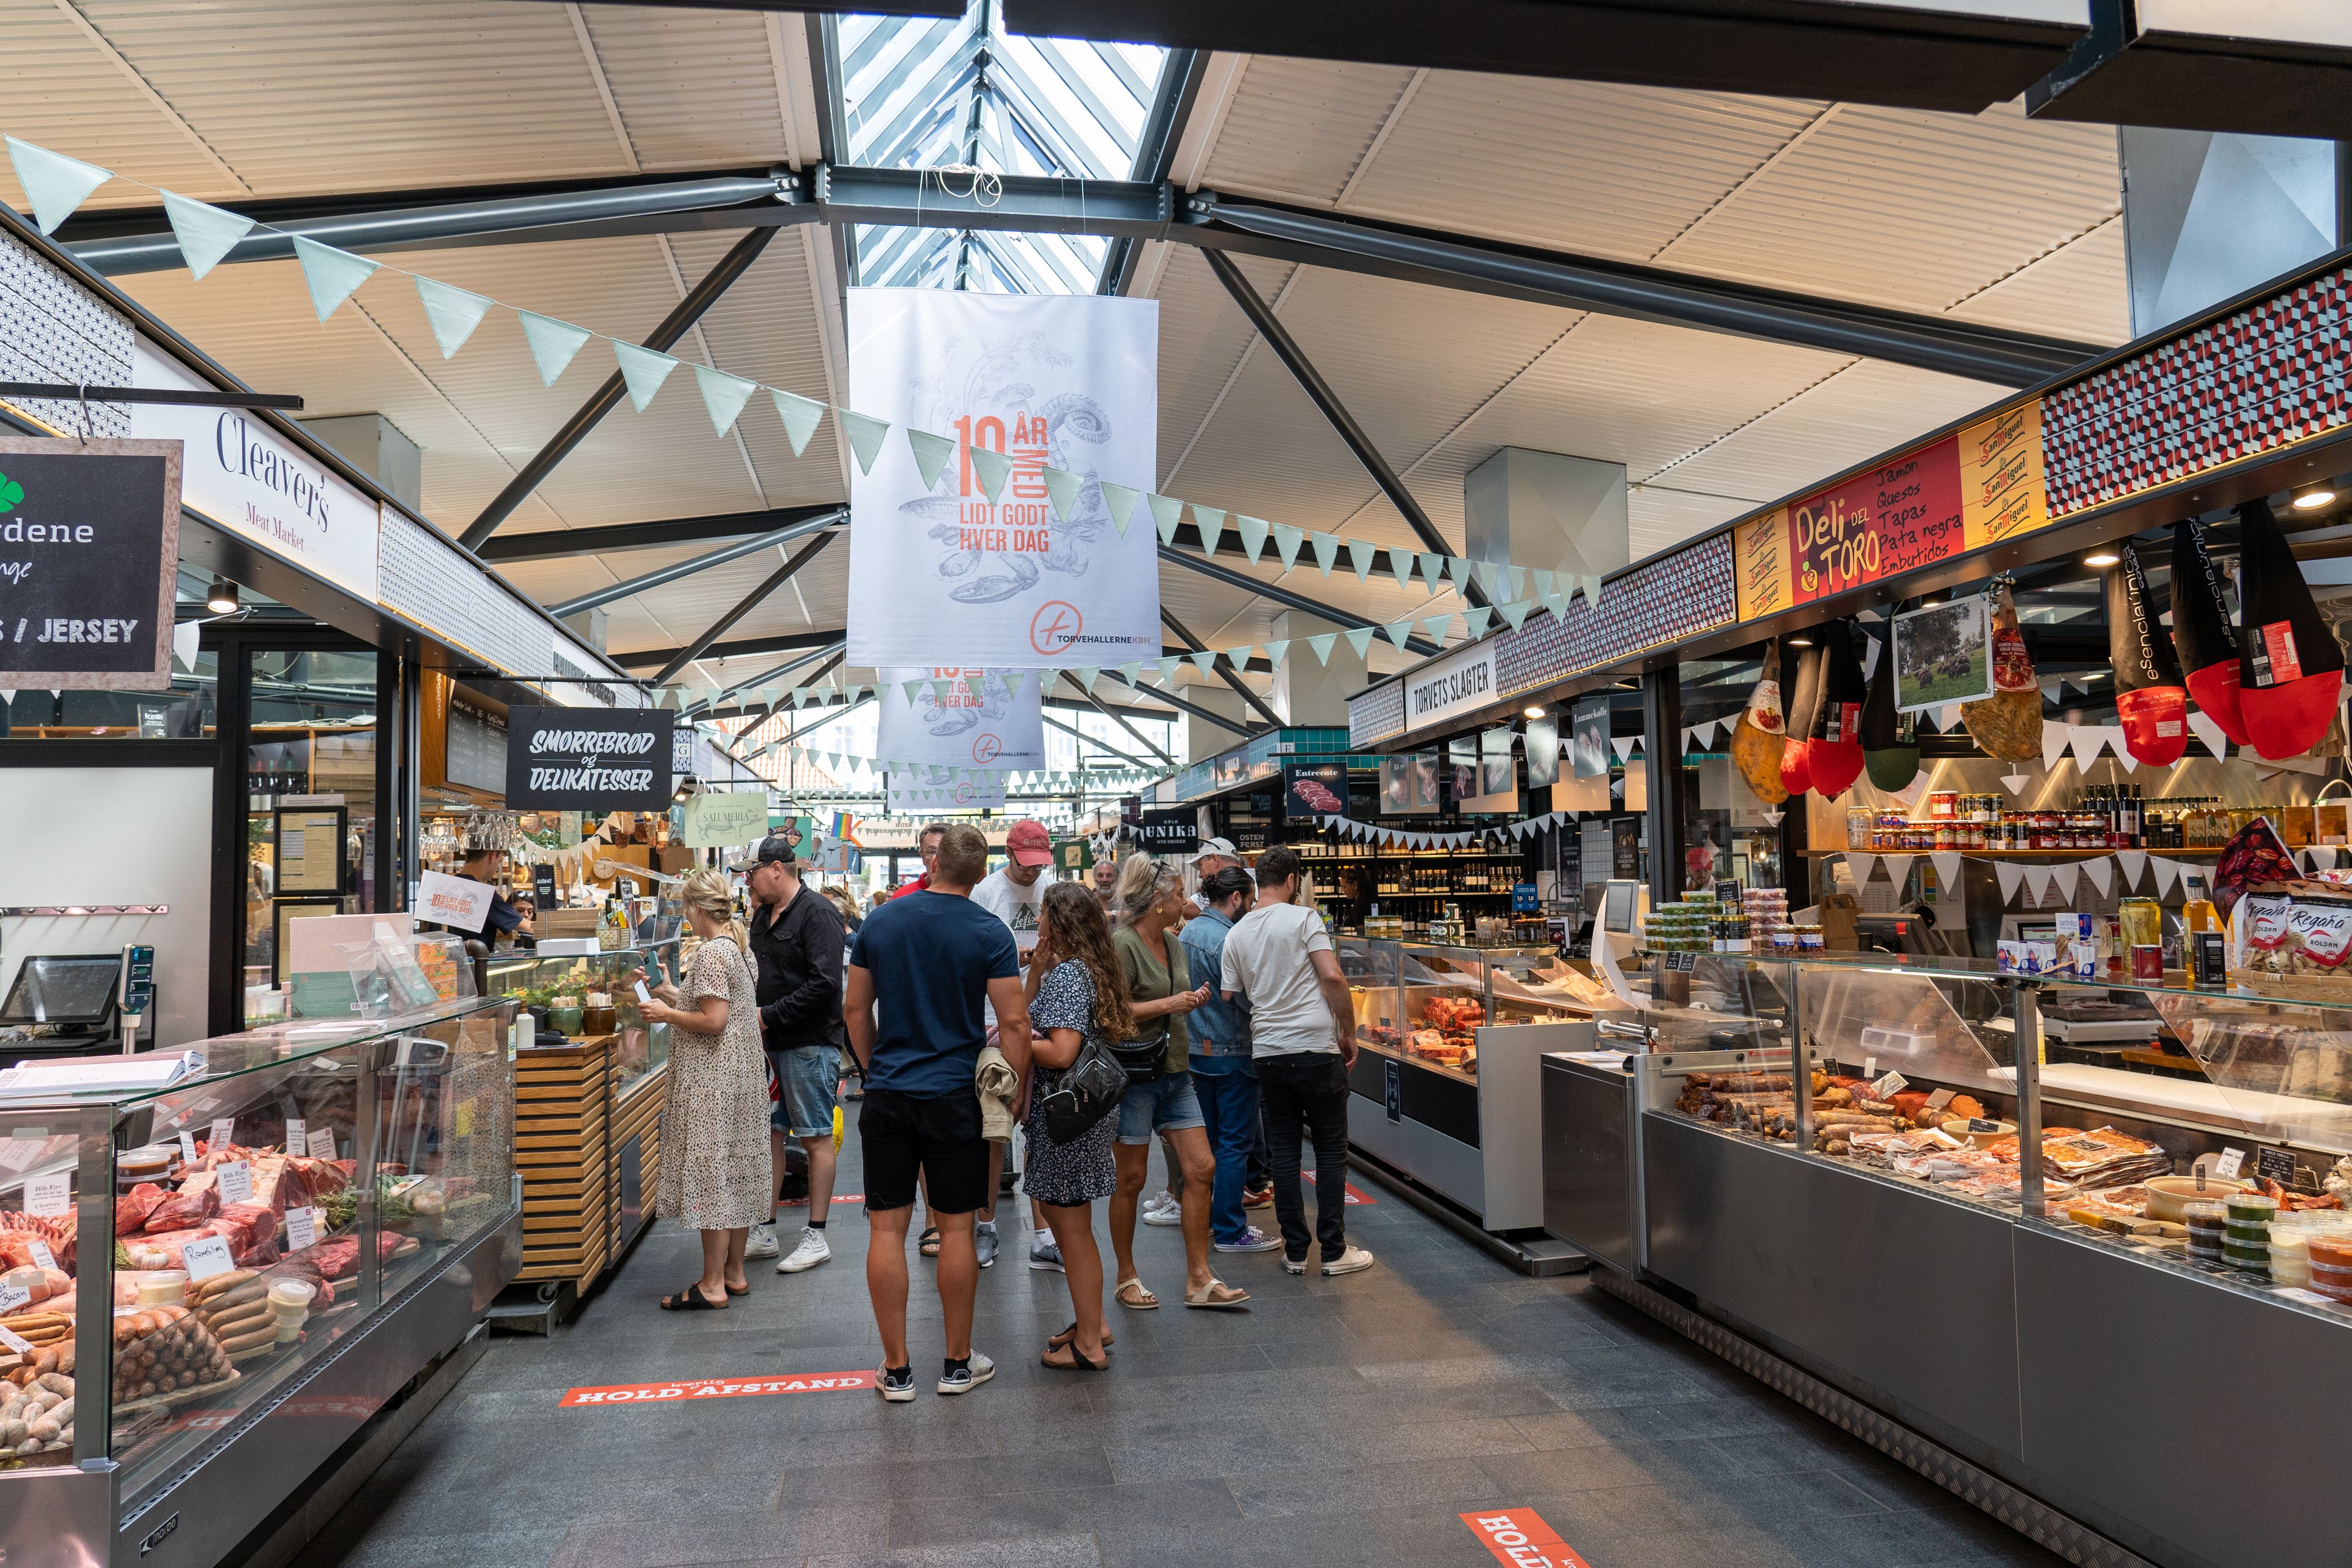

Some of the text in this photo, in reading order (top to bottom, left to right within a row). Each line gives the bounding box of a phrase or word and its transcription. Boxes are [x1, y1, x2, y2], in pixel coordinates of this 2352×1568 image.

[954, 411, 1048, 497] 10 ÅR
[217, 412, 329, 533] Cleaver's
[1013, 449, 1048, 499] MED
[1877, 483, 1920, 508] Quesos
[246, 501, 304, 552] Meat Market
[960, 503, 1049, 526] LIDT GODT
[1796, 498, 1870, 553] Deli DEL
[1878, 504, 1927, 530] Tapas
[0, 517, 93, 543] dene
[960, 528, 1049, 553] HVER DAG
[1879, 514, 1963, 553] Pata negra
[1820, 530, 1879, 586] TORO
[1881, 540, 1948, 576] Embutidos
[37, 618, 138, 643] JERSEY
[1415, 662, 1489, 715] TORVETS SLAGTER
[530, 729, 655, 755] SMØRREBRØD
[678, 746, 688, 755] G
[581, 754, 597, 768] og
[530, 767, 653, 791] DELIKATESSER
[703, 812, 749, 822] SALUMERIA
[1146, 825, 1196, 837] UNIKA
[430, 893, 440, 906] 10
[445, 903, 458, 911] HVER
[446, 896, 458, 905] LIDT
[2310, 940, 2337, 948] ROLDAN
[575, 1377, 863, 1403] HOLD AFSTAND
[1477, 1516, 1553, 1568] HOLD
